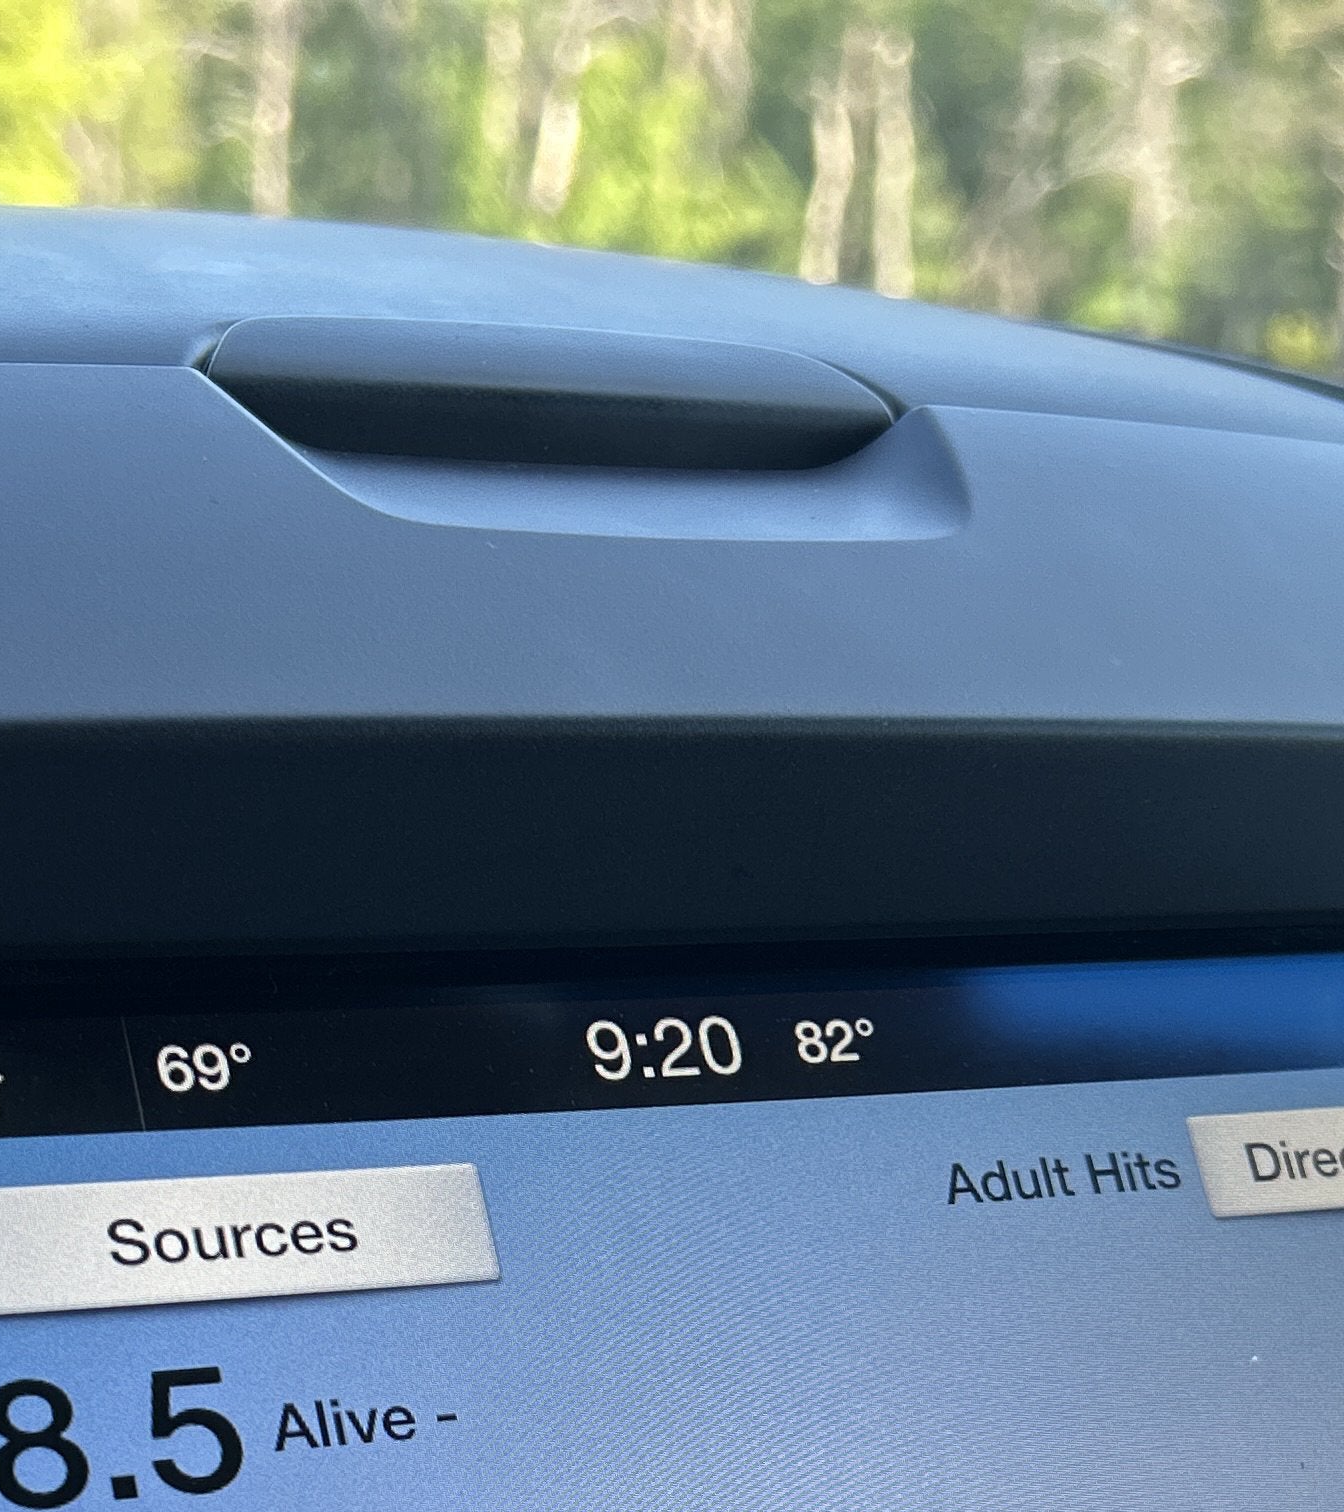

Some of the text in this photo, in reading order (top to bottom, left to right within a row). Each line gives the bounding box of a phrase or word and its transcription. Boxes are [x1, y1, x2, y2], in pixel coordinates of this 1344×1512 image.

[586, 1016, 742, 1081] 9:20
[794, 1018, 874, 1064] 82°
[157, 1043, 251, 1092] 69°
[947, 1151, 1182, 1205] Adult Hits
[107, 1218, 358, 1267] Sources
[275, 1399, 416, 1452] Alive
